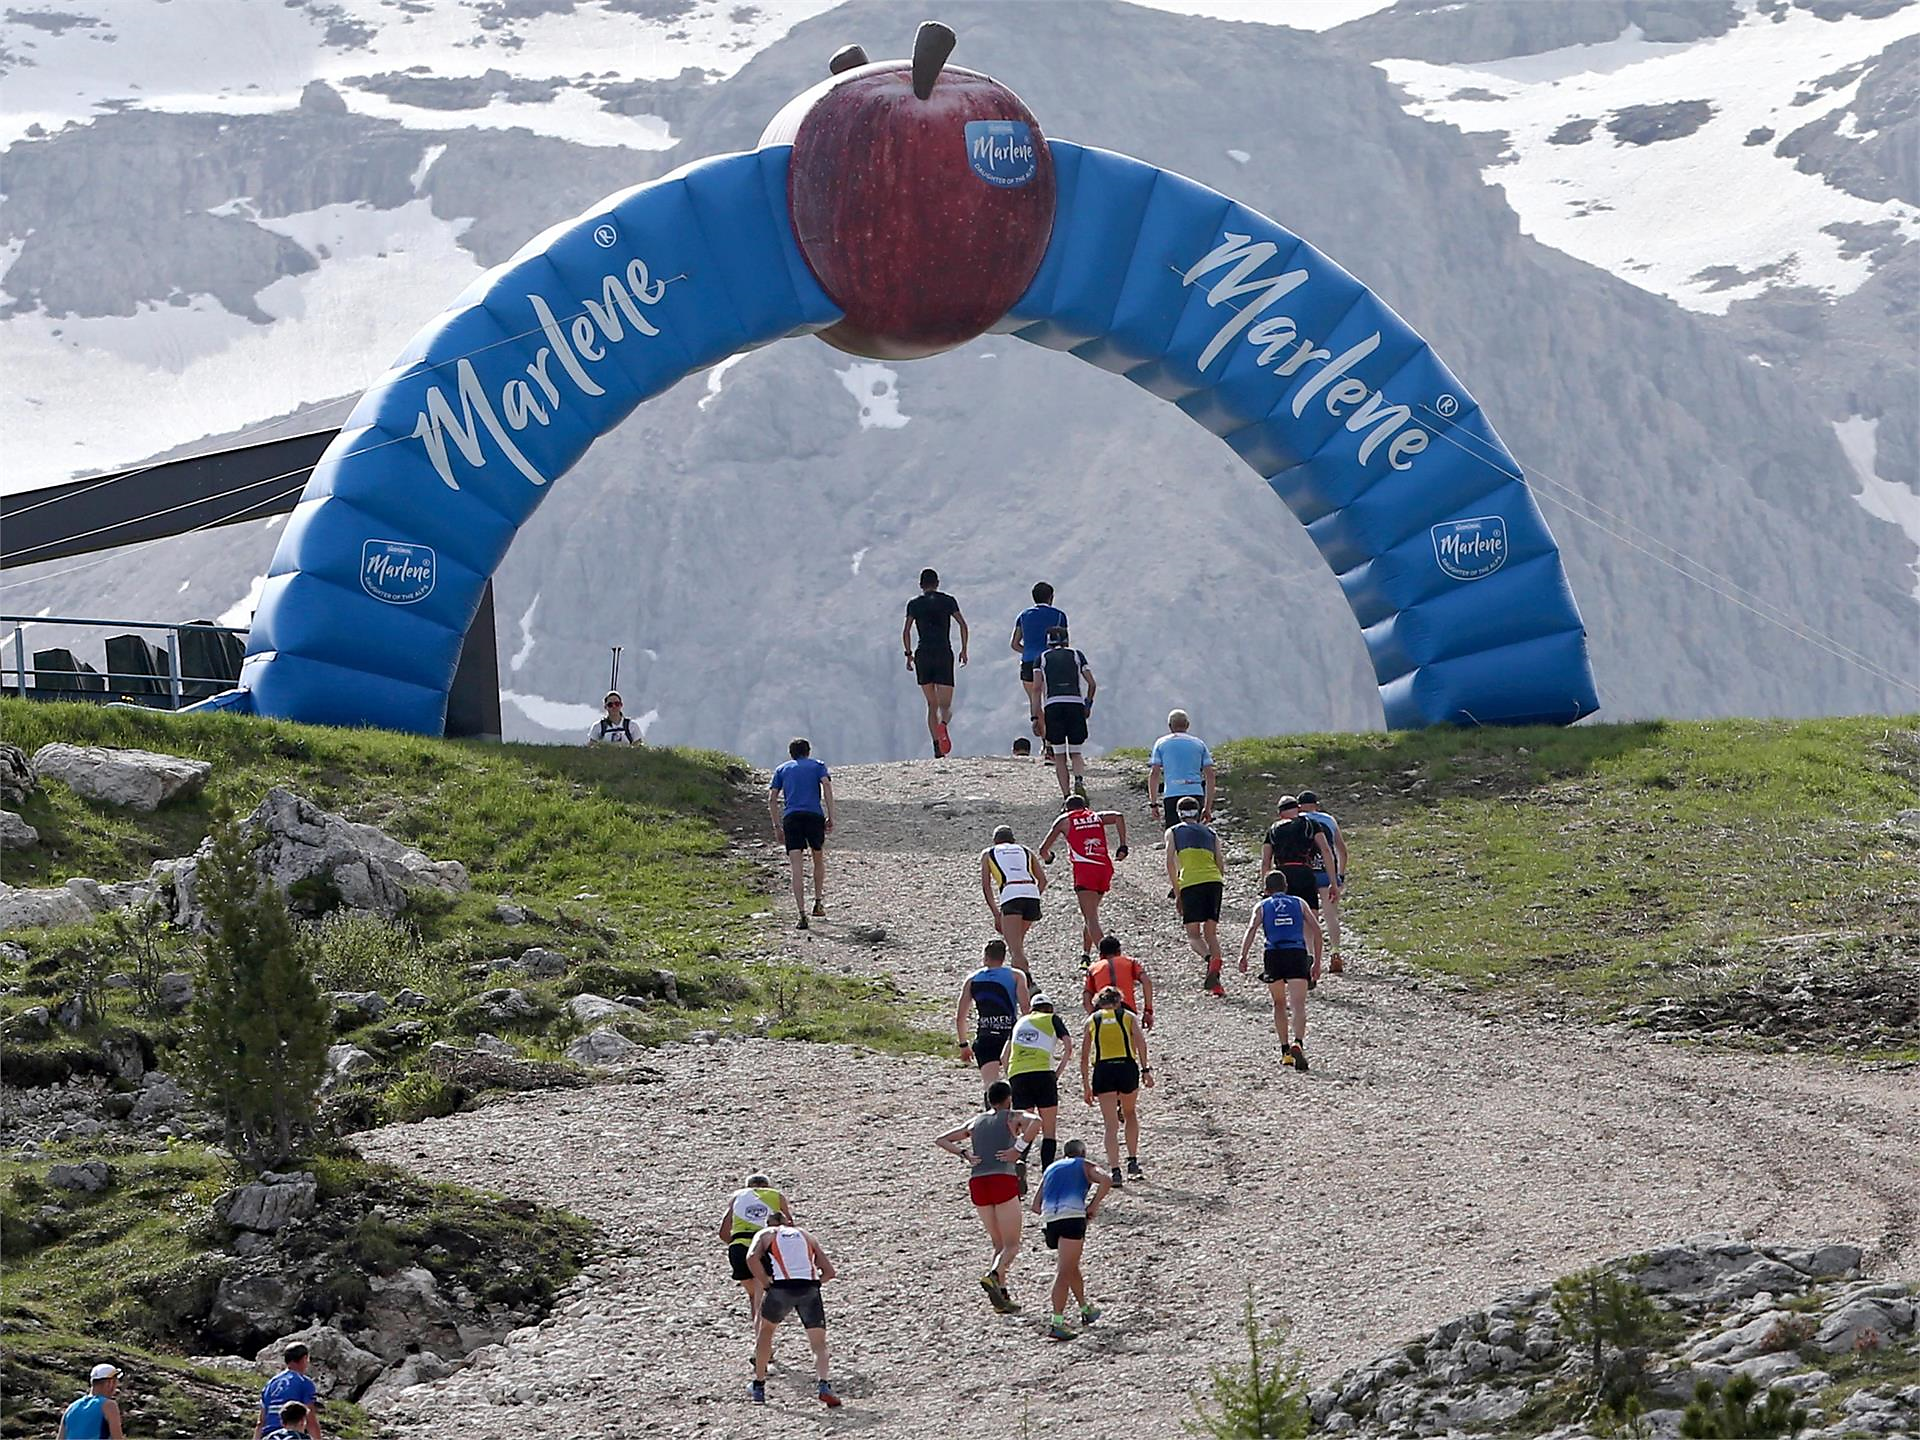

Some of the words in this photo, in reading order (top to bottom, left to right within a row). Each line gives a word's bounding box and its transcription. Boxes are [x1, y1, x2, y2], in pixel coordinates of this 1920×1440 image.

[973, 135, 1033, 171] Marlene
[1183, 232, 1429, 470] Marlene
[411, 258, 665, 490] Marlene
[1441, 532, 1502, 564] Marlene
[367, 554, 430, 585] Marlene
